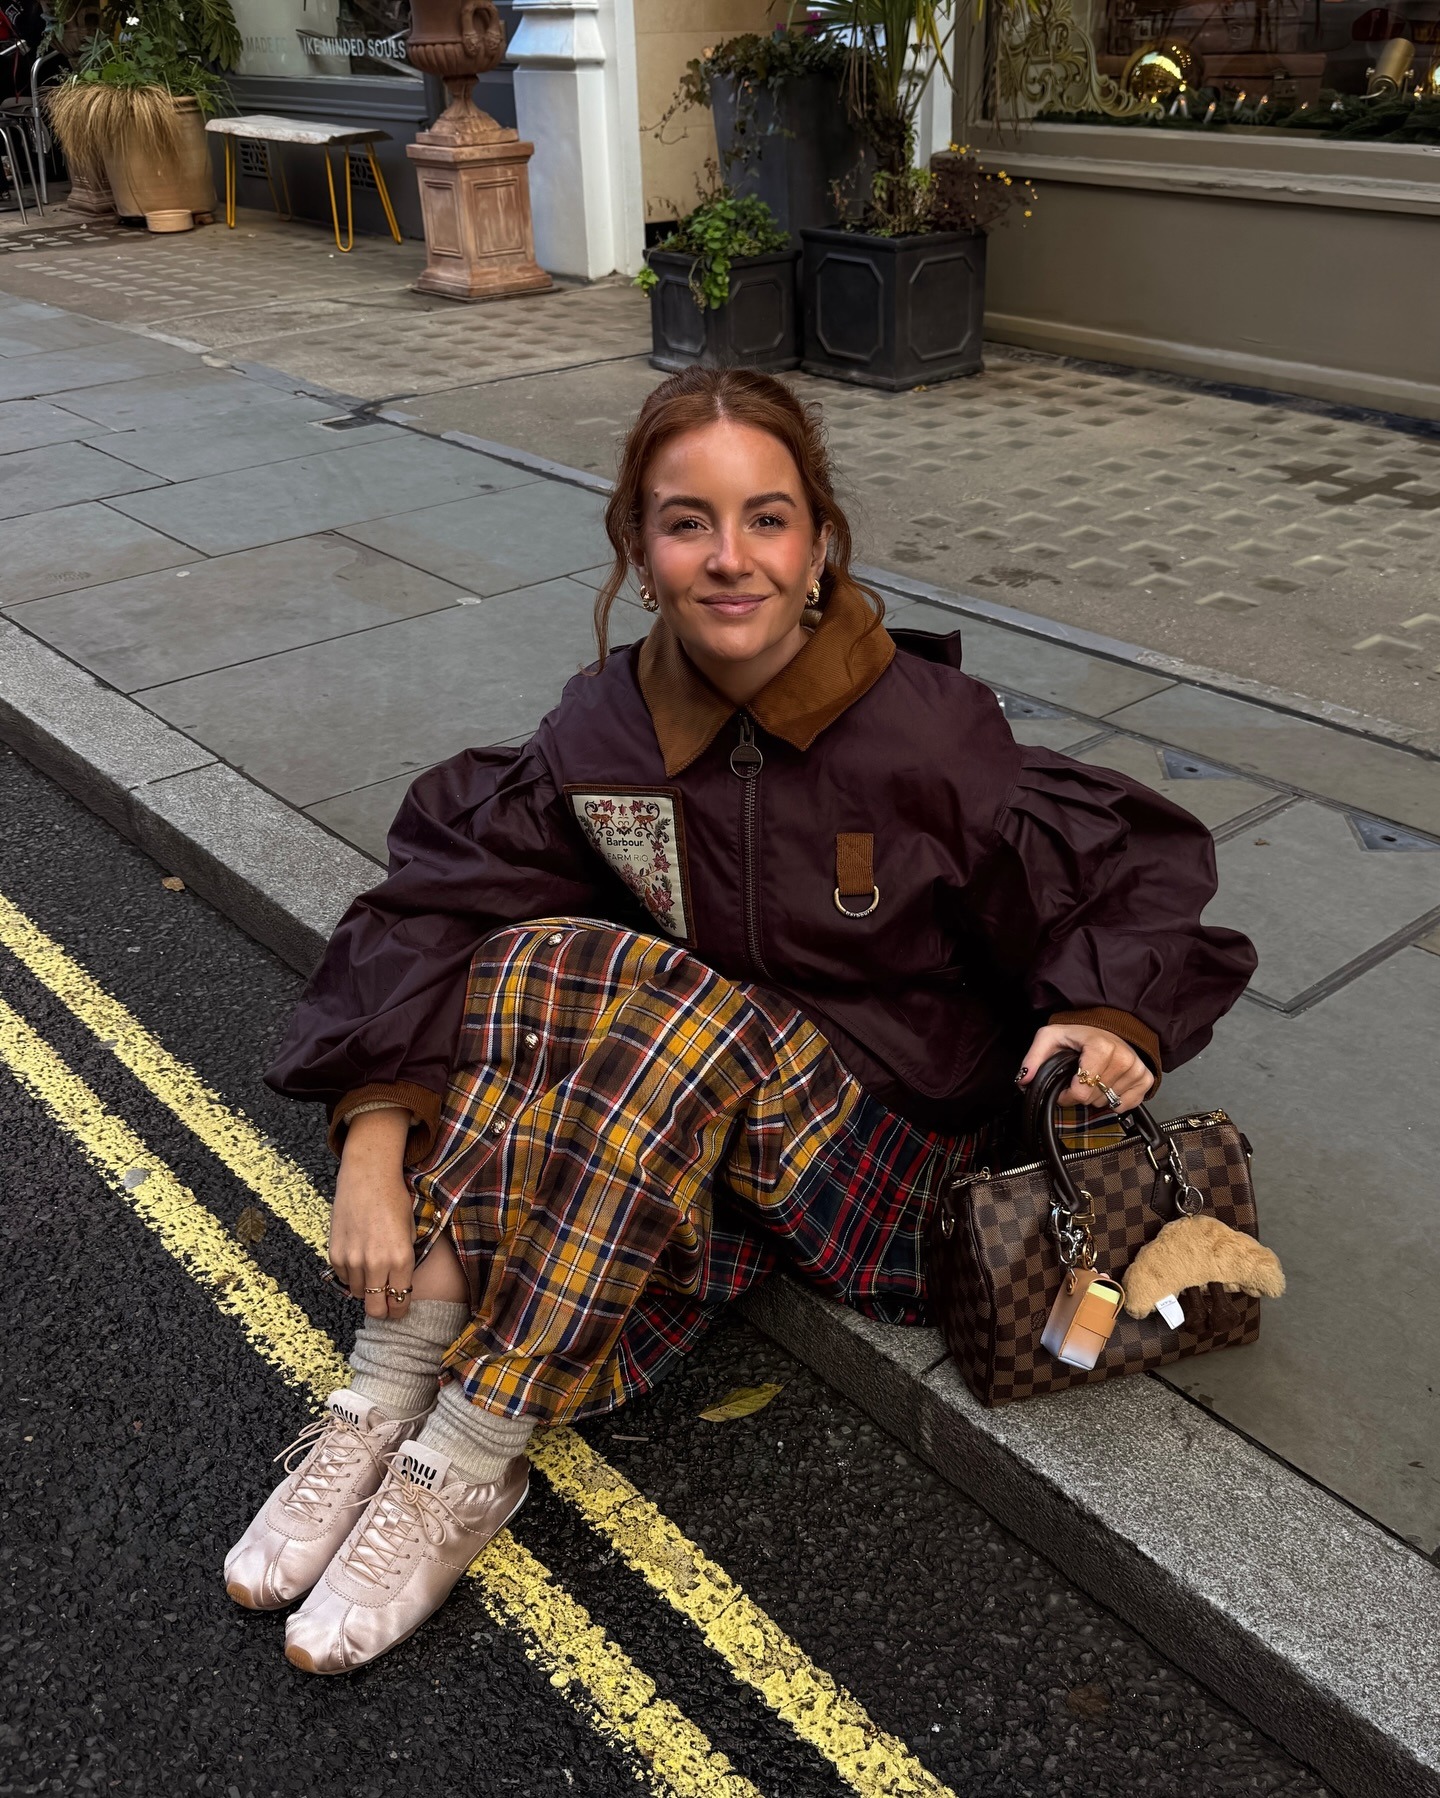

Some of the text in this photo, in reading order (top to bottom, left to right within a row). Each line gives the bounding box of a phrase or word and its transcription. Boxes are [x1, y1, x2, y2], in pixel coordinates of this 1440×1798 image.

[321, 37, 365, 56] MINDED
[367, 38, 407, 59] SOULS
[606, 852, 632, 862] FARM
